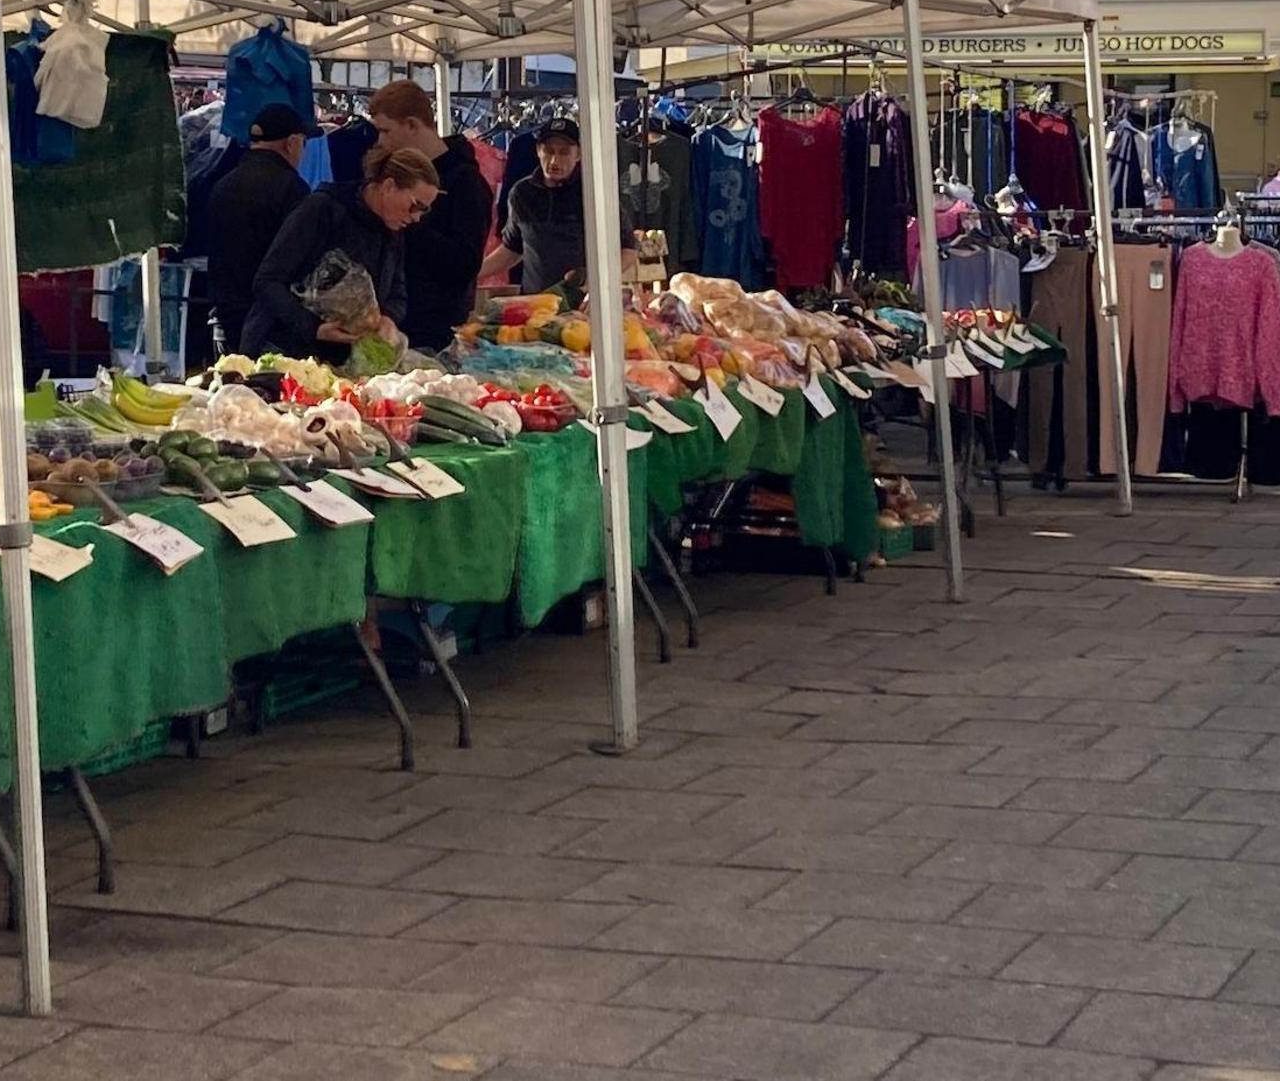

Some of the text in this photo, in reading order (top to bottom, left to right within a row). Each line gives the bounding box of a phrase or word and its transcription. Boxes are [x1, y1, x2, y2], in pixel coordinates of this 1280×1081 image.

[868, 39, 934, 53] POUD
[939, 38, 1026, 53] BURGERS
[1054, 37, 1121, 53] JUBO
[1126, 36, 1166, 50] HOT
[1171, 35, 1225, 50] DOGS
